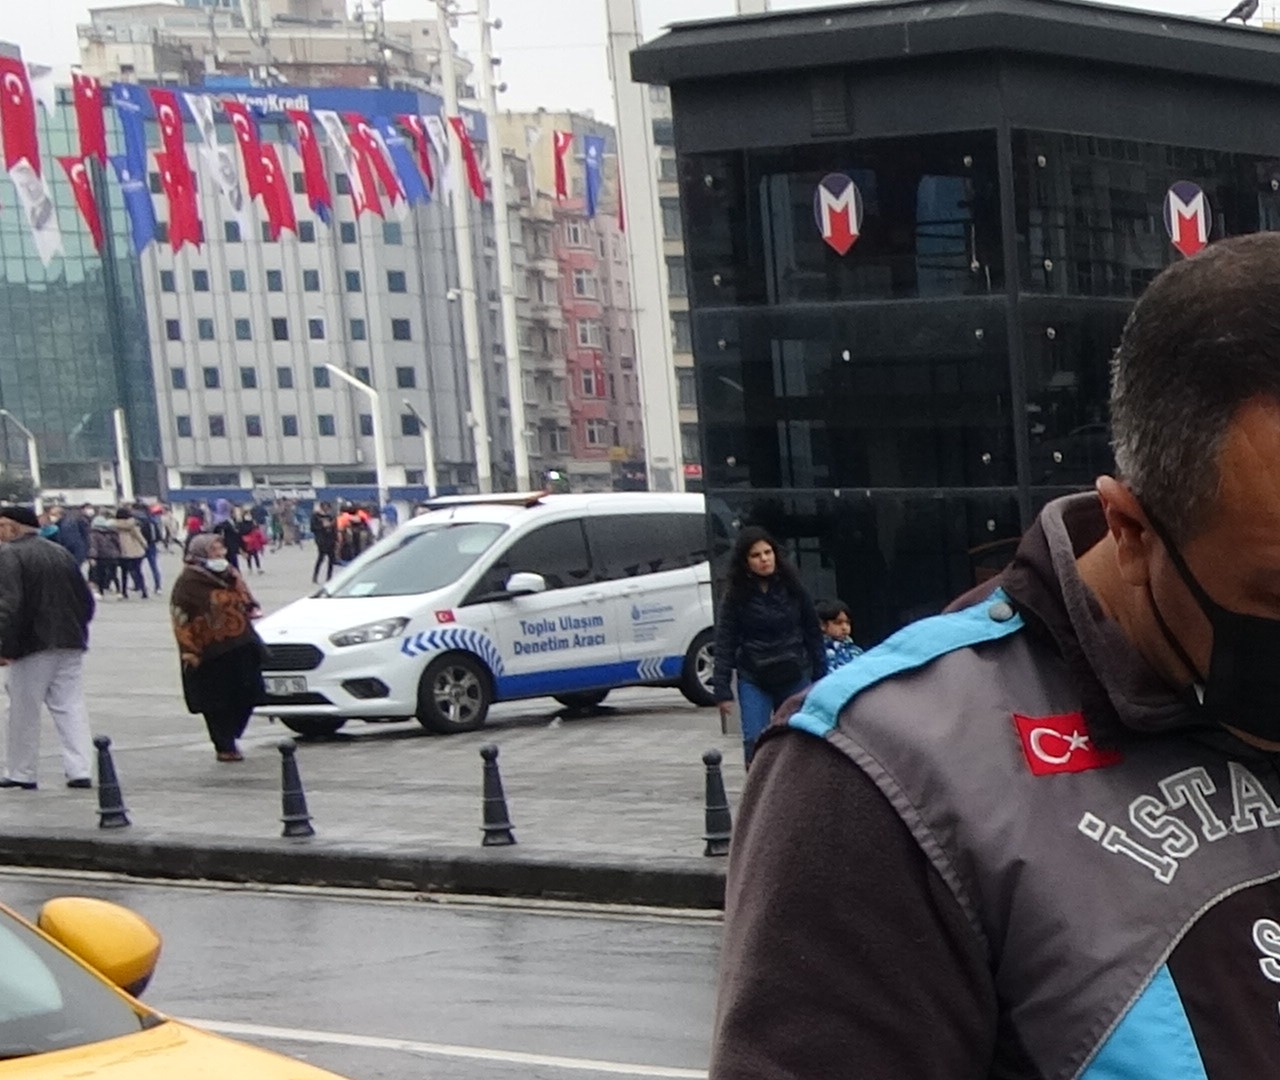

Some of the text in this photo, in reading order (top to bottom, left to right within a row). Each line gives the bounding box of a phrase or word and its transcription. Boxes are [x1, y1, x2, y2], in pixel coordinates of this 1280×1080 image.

[519, 615, 604, 637] Toplu Ulaşım
[514, 633, 605, 655] Denetim Aracı
